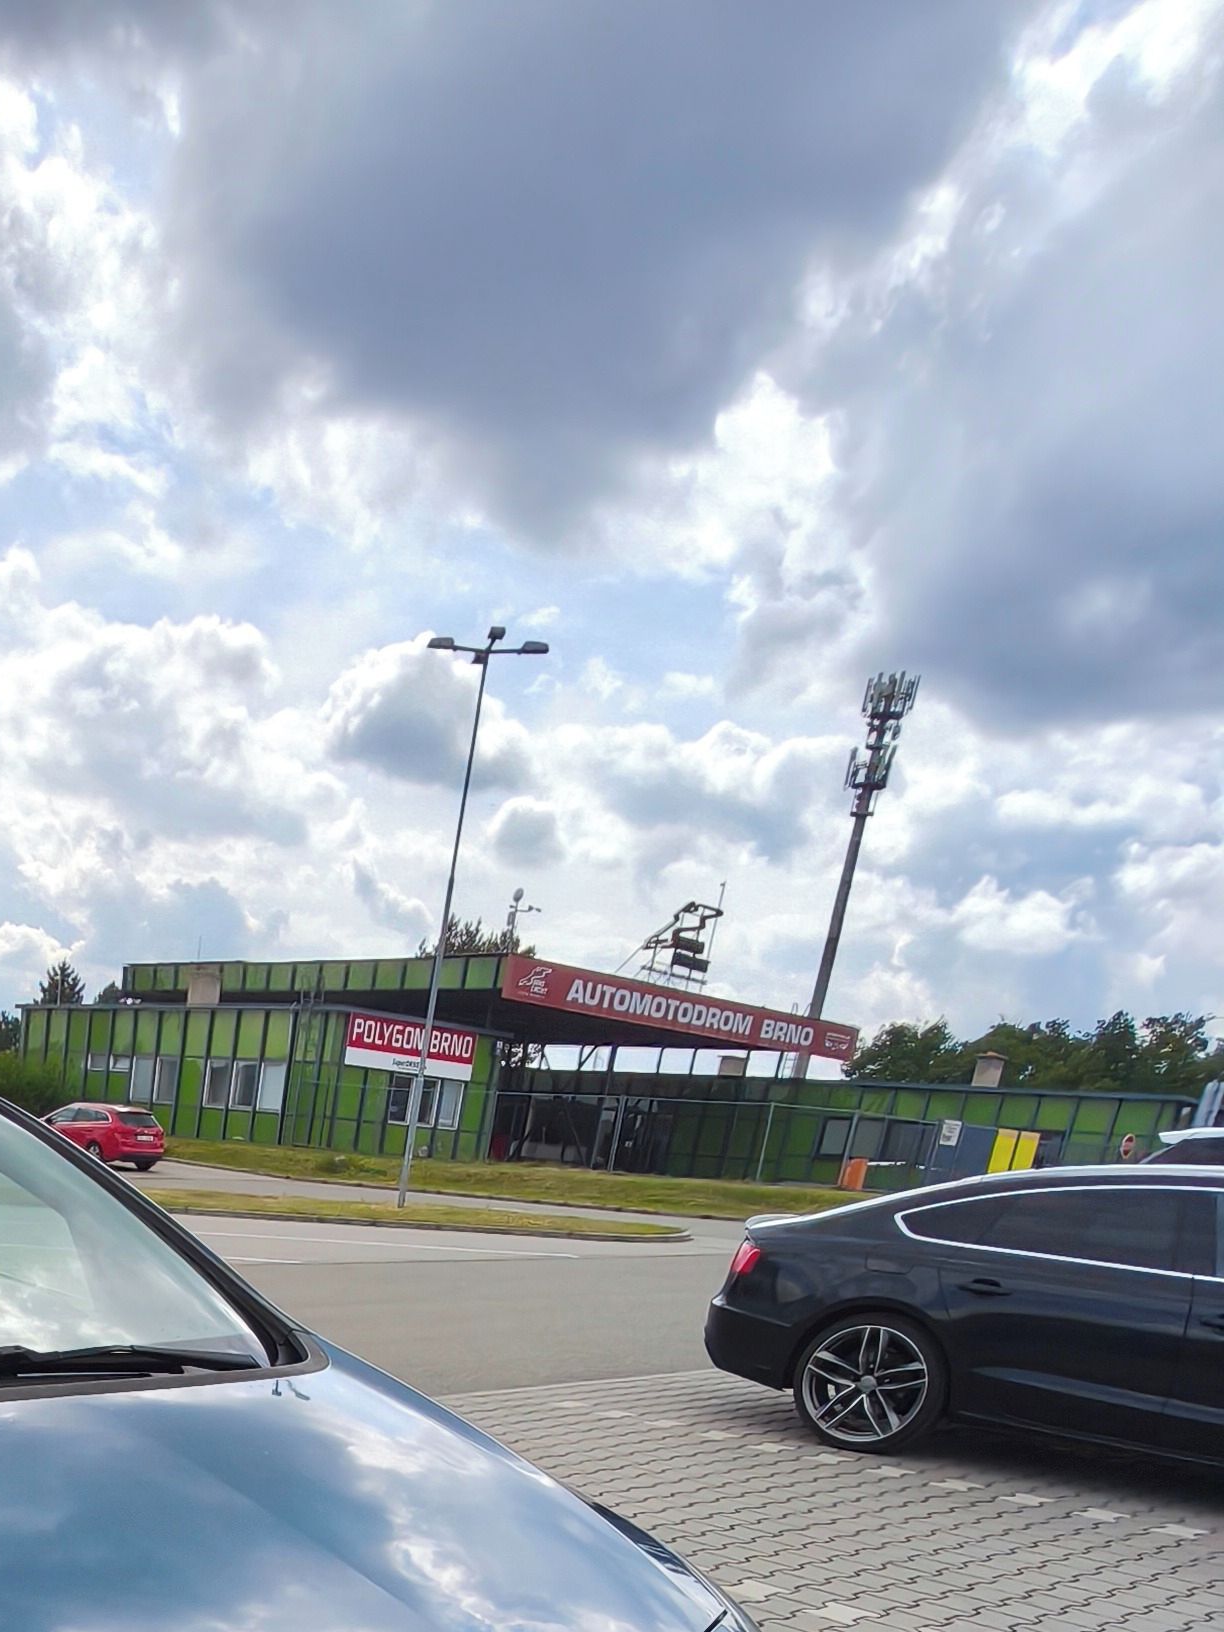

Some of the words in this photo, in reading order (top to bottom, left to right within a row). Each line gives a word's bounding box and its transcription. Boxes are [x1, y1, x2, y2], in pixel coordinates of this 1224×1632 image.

[352, 1018, 425, 1051] POLYGON
[429, 1030, 473, 1058] BRNO
[566, 979, 753, 1036] AUTOMOTODROM
[760, 1018, 814, 1046] BRNO
